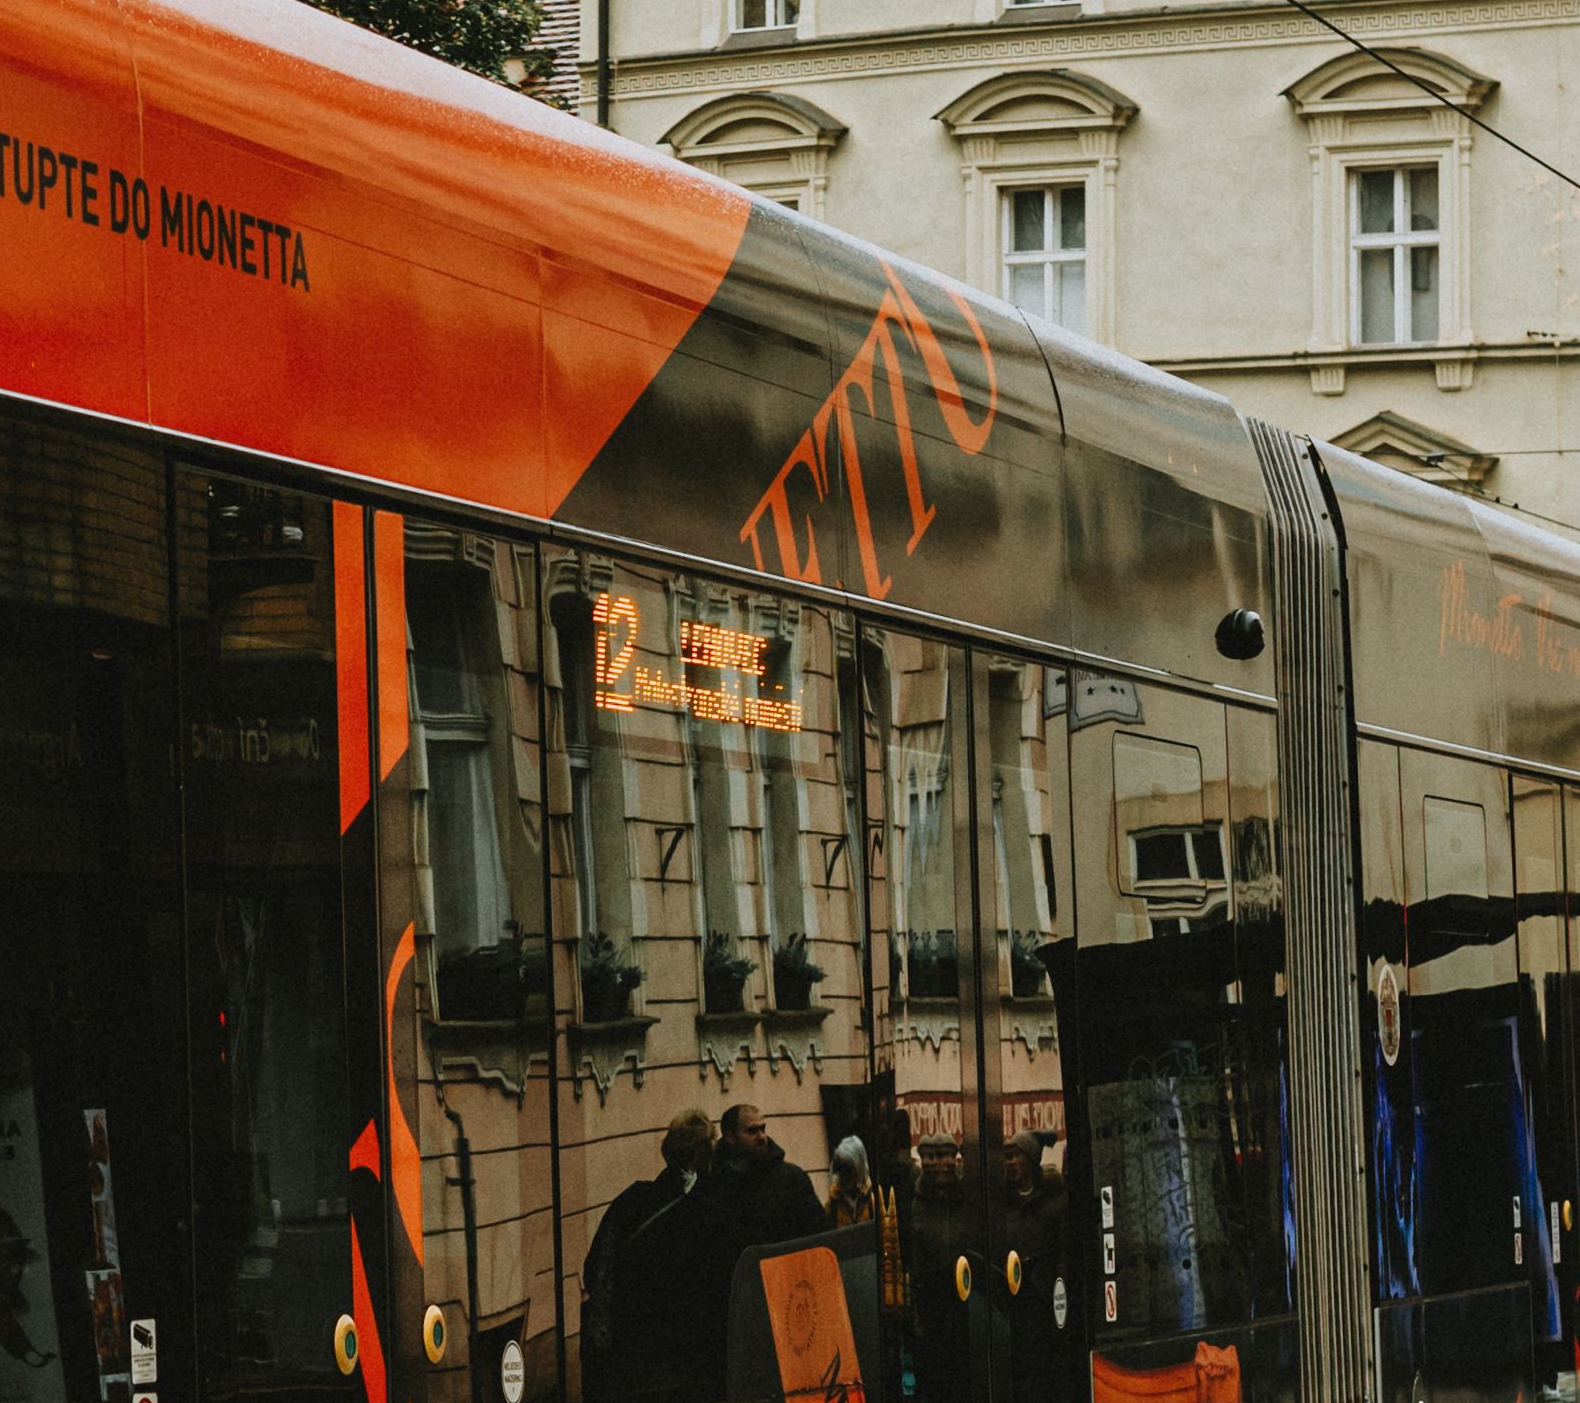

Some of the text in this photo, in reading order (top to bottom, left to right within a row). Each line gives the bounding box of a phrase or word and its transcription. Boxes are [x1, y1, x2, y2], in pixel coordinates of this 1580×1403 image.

[108, 168, 151, 241] DO
[159, 184, 311, 293] MIONETTA
[592, 592, 638, 713] 12
